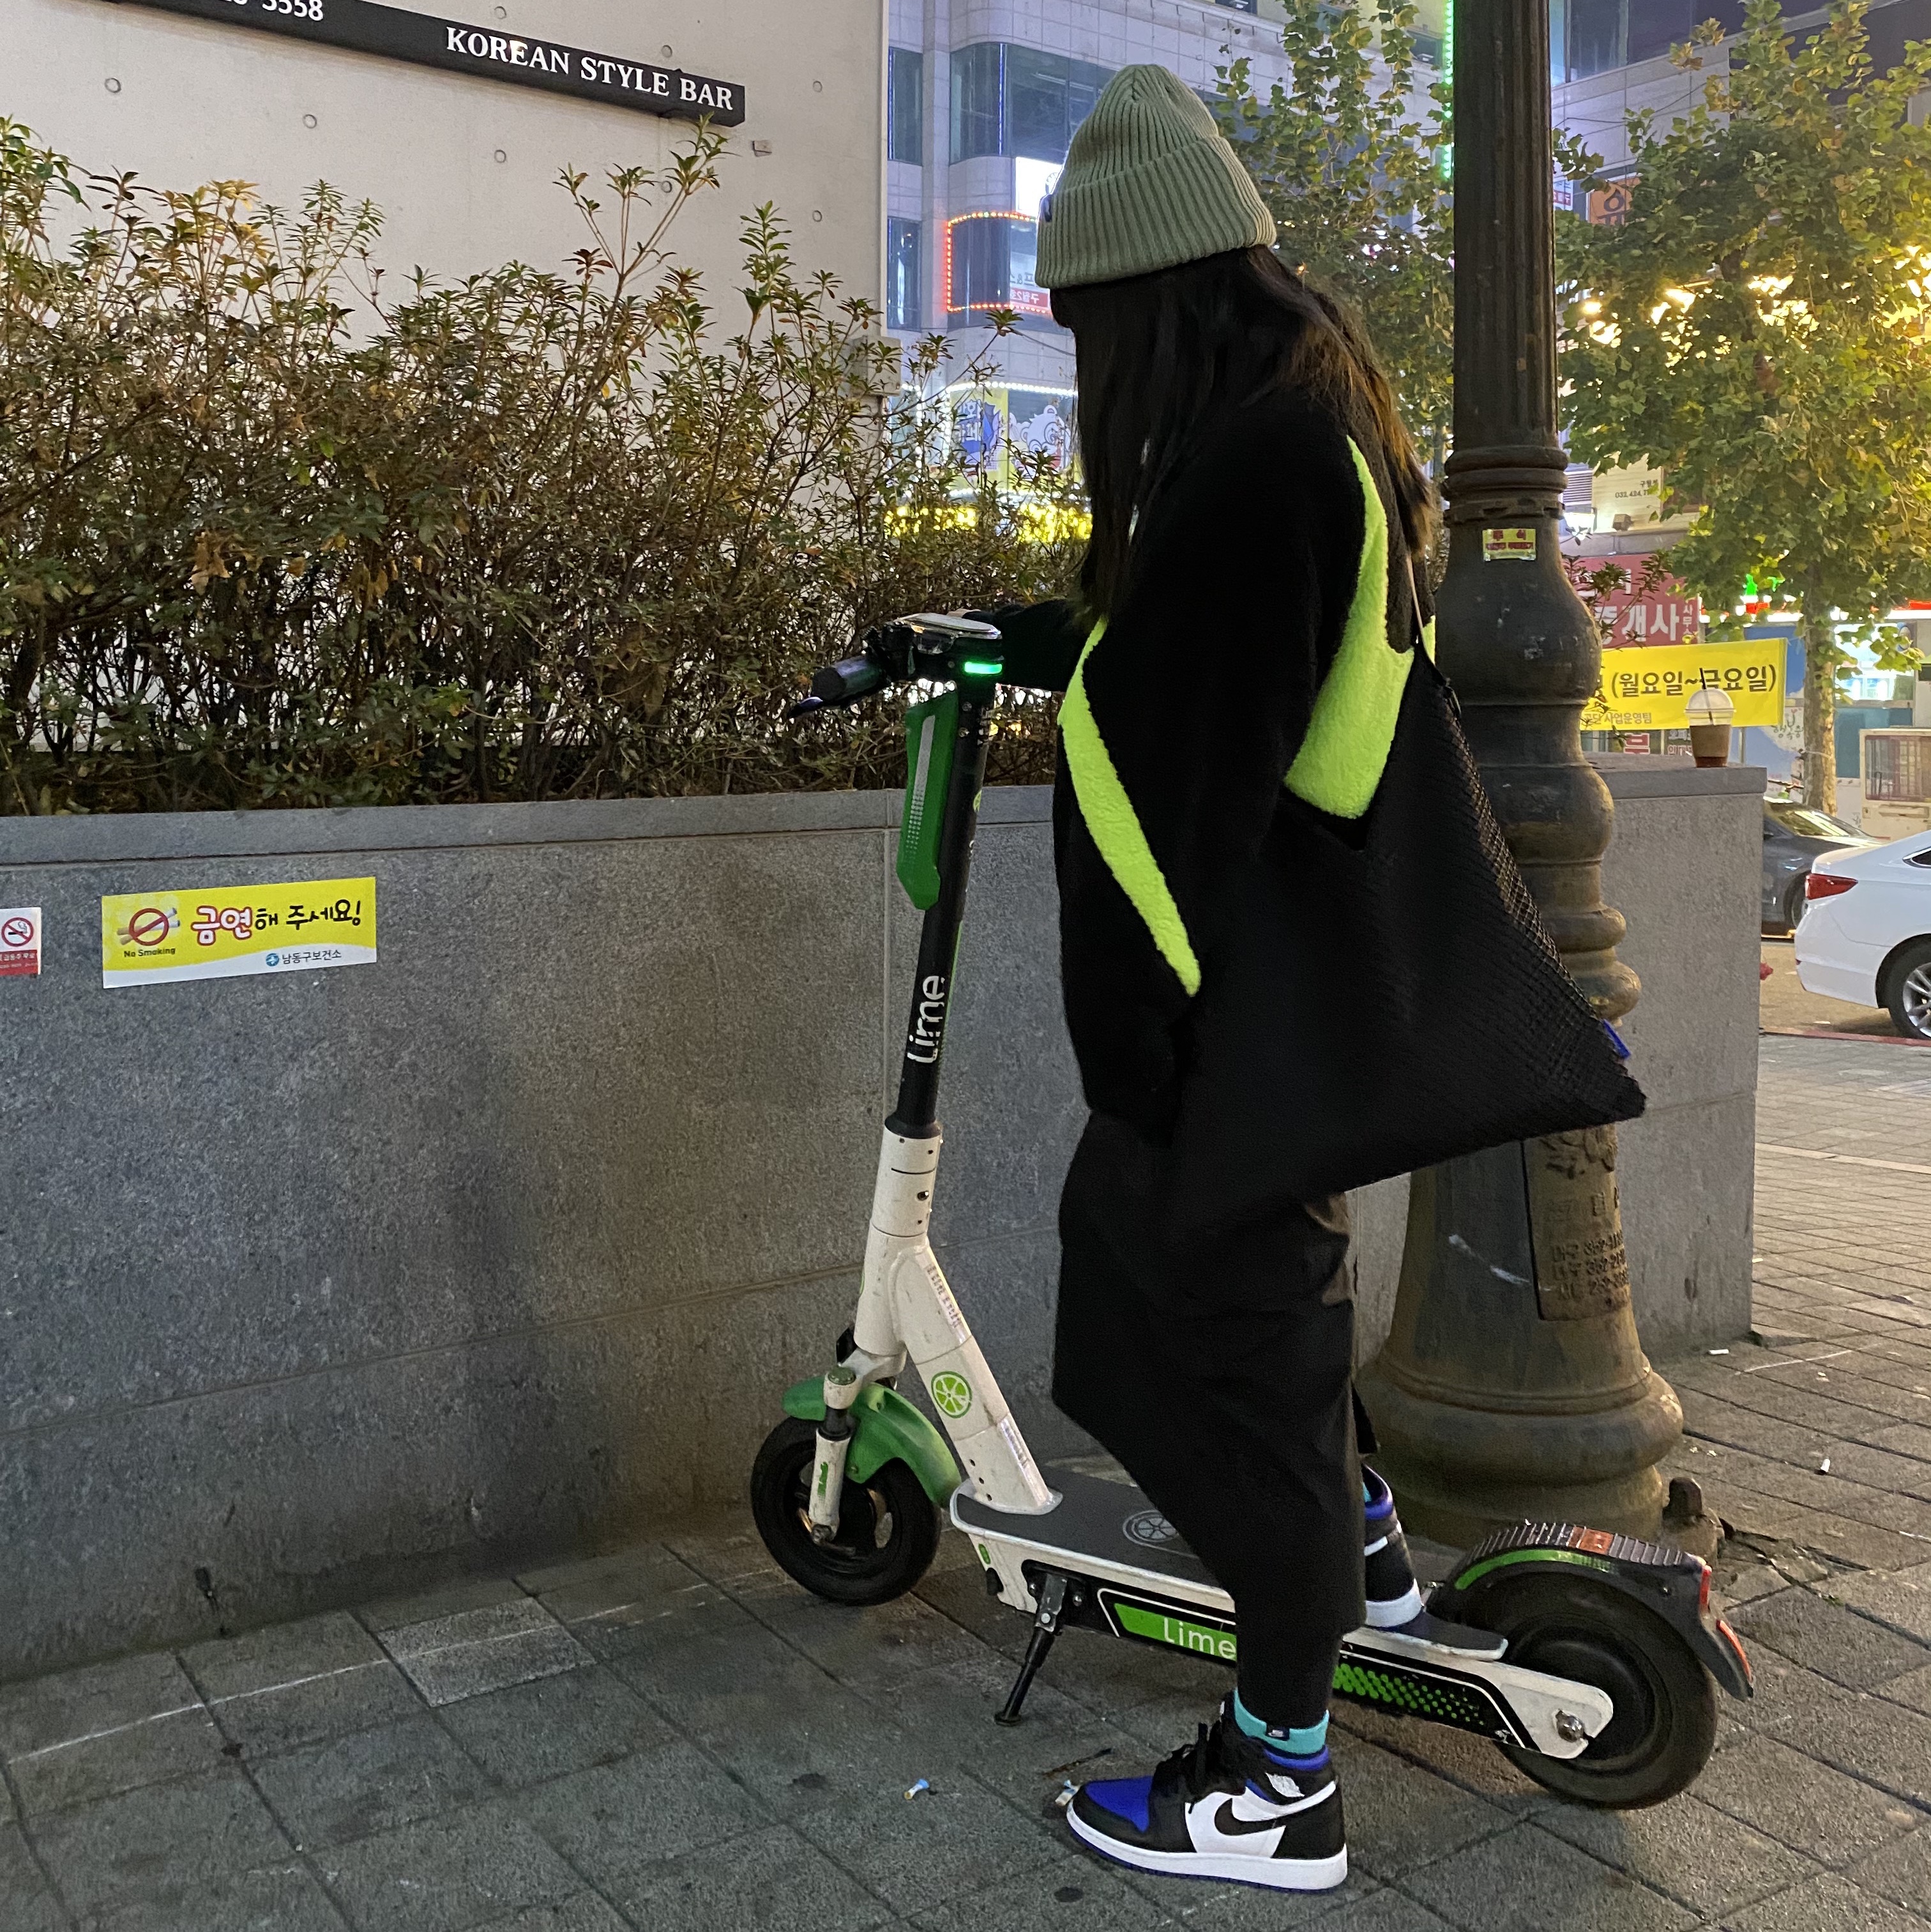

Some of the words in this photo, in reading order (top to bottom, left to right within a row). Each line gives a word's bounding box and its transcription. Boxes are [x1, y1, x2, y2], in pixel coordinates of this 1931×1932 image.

[446, 27, 570, 75] KOREAN
[580, 56, 670, 96] STYLE
[679, 77, 734, 110] BAR
[1611, 664, 1776, 698] (월요일~금요일)
[1604, 711, 1653, 724] 사업운영팀
[191, 904, 278, 946] 금연해
[286, 899, 361, 931] 주세요!
[124, 949, 135, 958] No
[137, 947, 176, 957] Smoking
[282, 948, 342, 965] 남동구보건소
